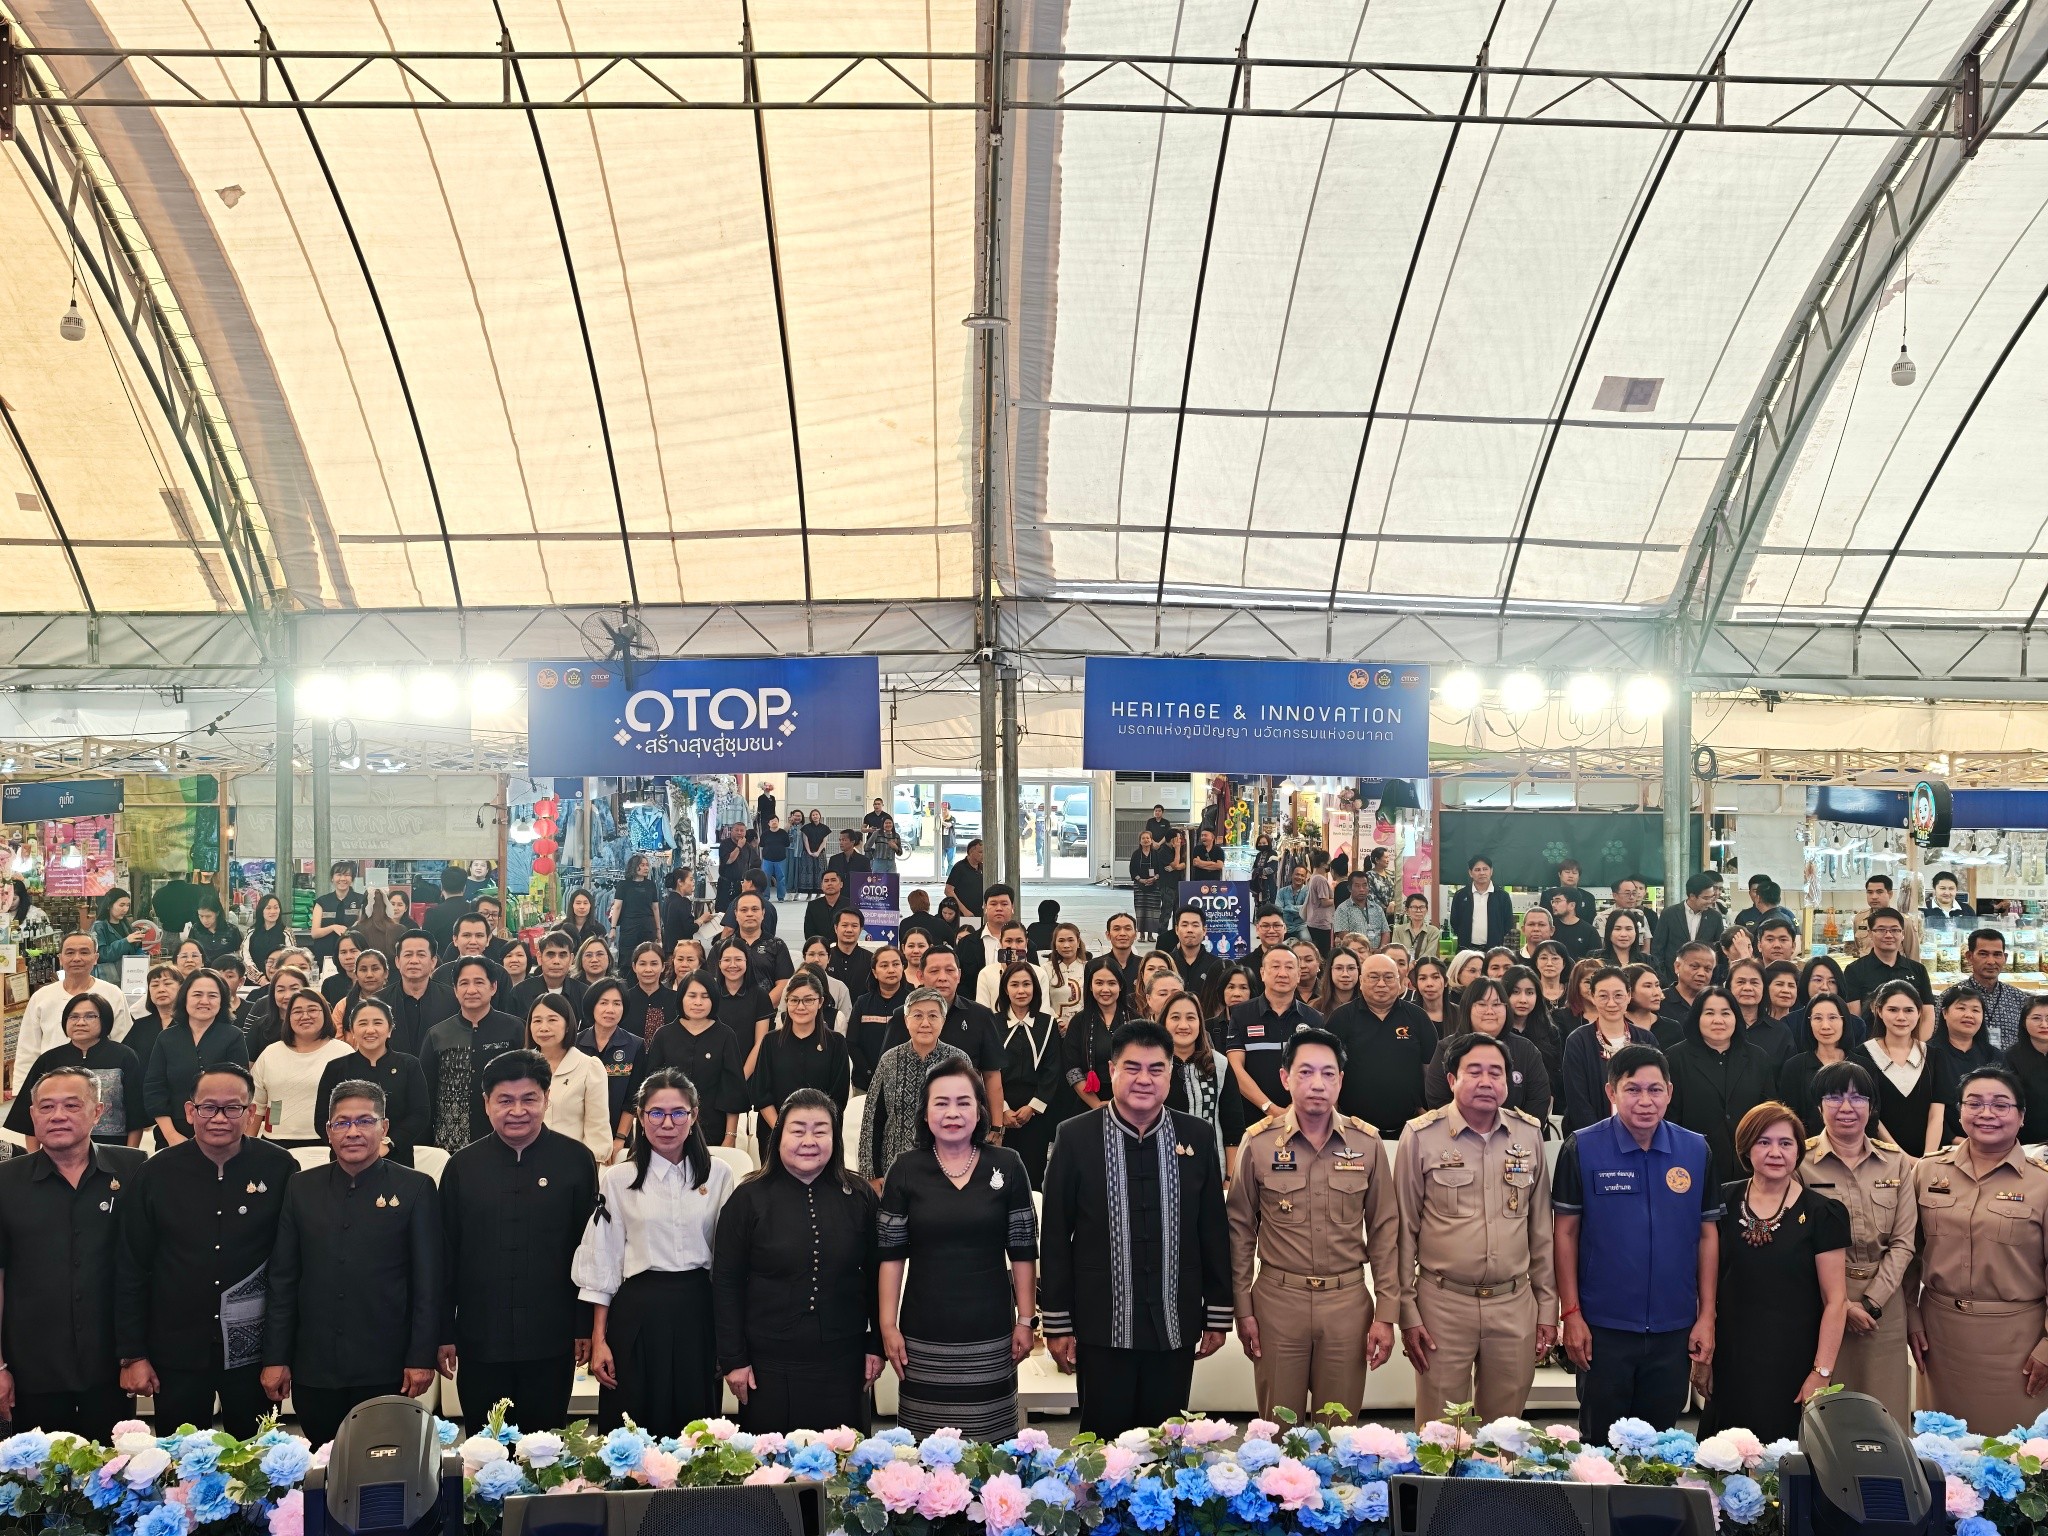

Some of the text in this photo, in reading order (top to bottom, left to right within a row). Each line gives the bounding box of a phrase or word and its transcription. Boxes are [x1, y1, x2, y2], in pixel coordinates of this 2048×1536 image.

[625, 688, 792, 733] OTOP
[1111, 701, 1402, 724] HERITAGE & INNOVATION
[1118, 725, 1394, 742] มรดกแห่งภูมิปัญญา นวัตกรรมแห่งอนาคต
[645, 733, 773, 758] สร้างสุขสู่ชุมชน
[862, 886, 888, 896] OTOP
[1188, 896, 1238, 910] OTOP
